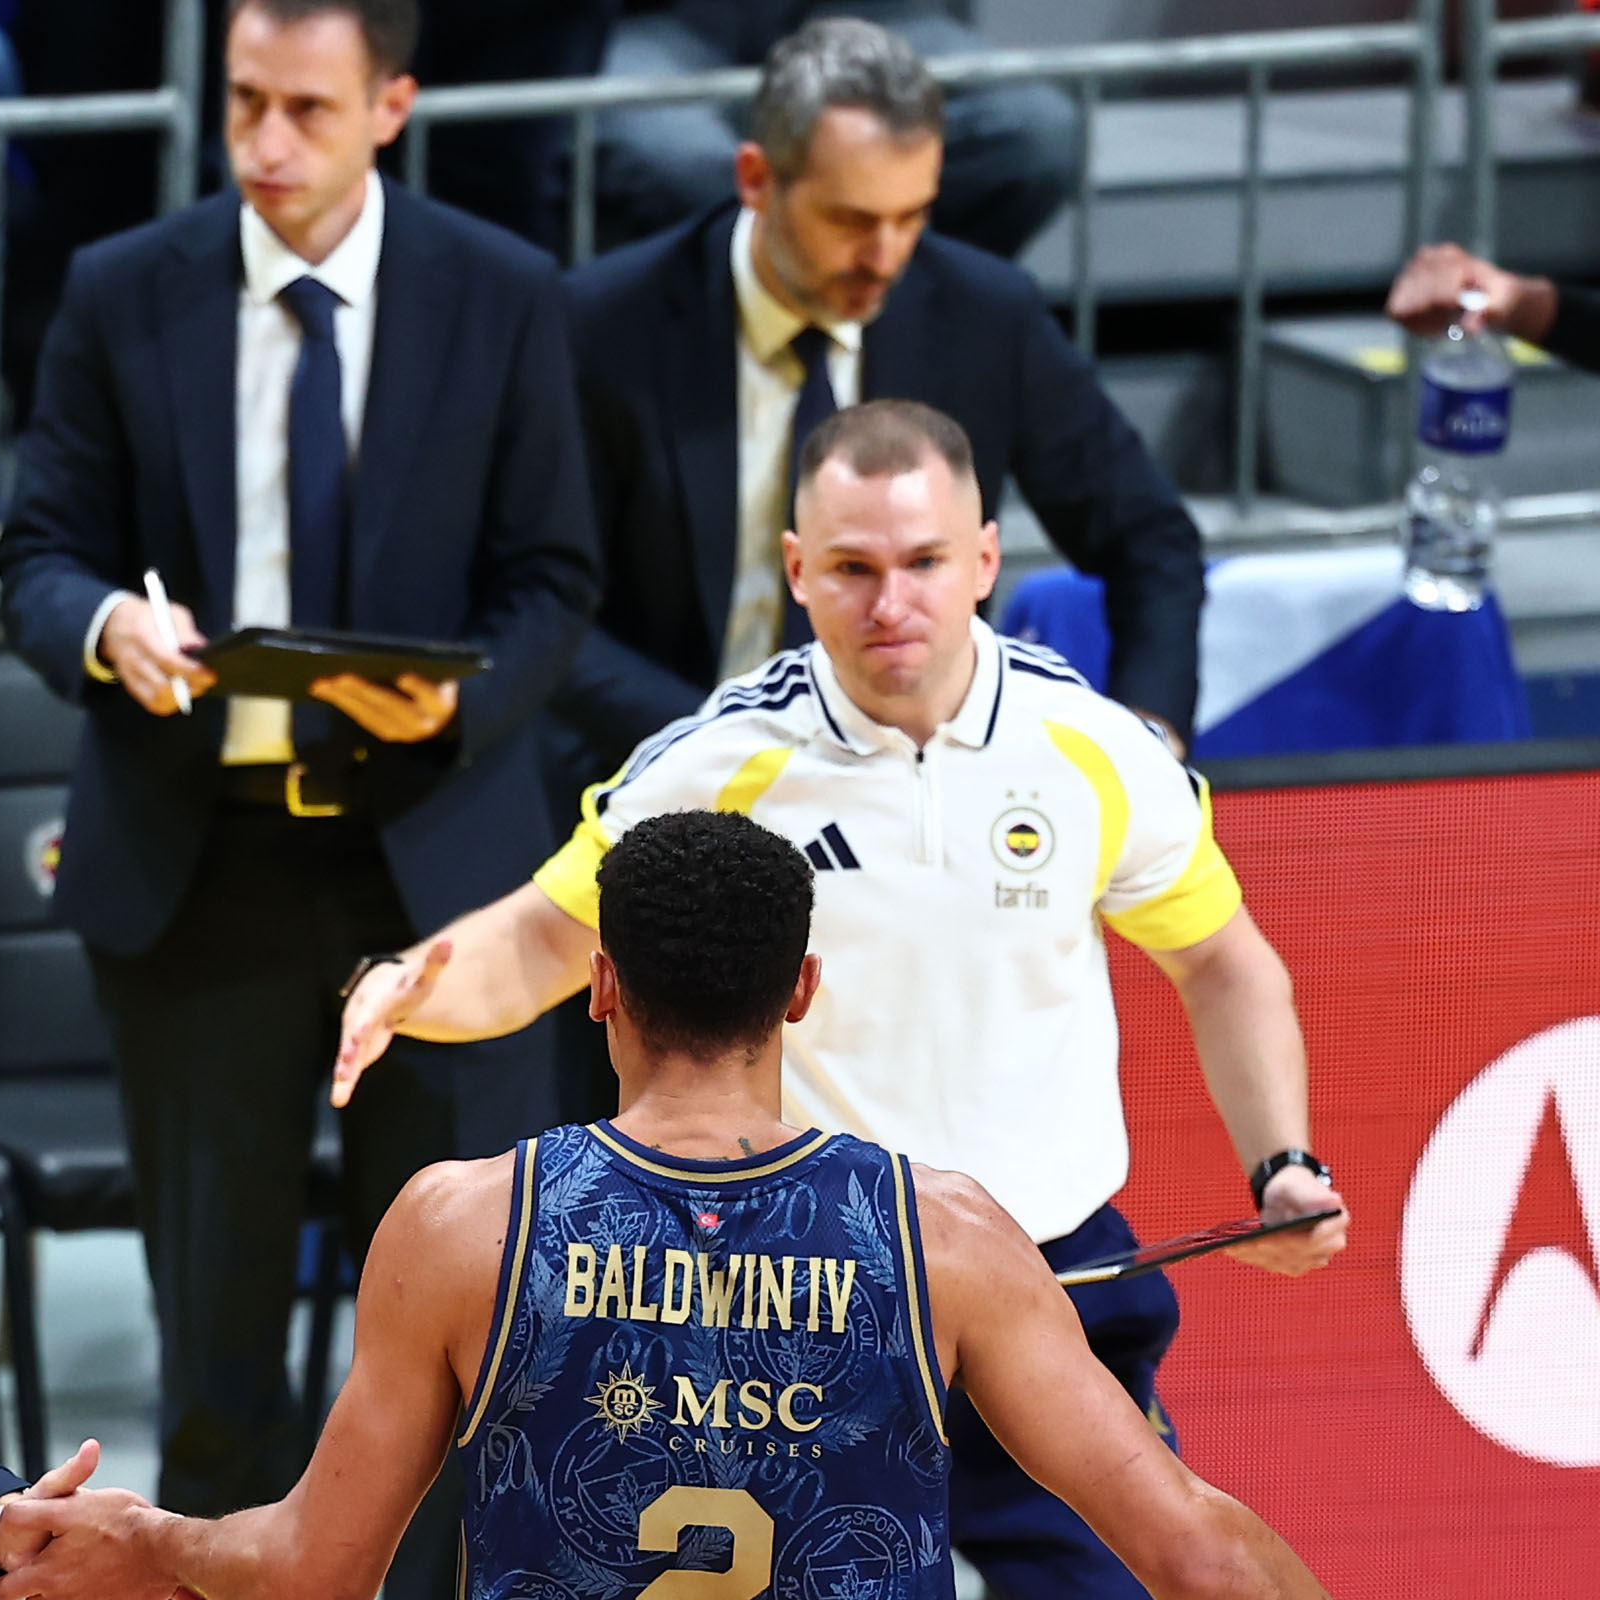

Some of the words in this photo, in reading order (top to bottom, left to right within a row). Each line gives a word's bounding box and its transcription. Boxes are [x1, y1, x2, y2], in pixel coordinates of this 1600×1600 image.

[996, 881, 1049, 908] tarfin
[563, 1243, 794, 1331] BALDWIN
[807, 1257, 857, 1334] IV
[669, 1375, 825, 1433] MSC
[669, 1436, 823, 1458] CRUISES
